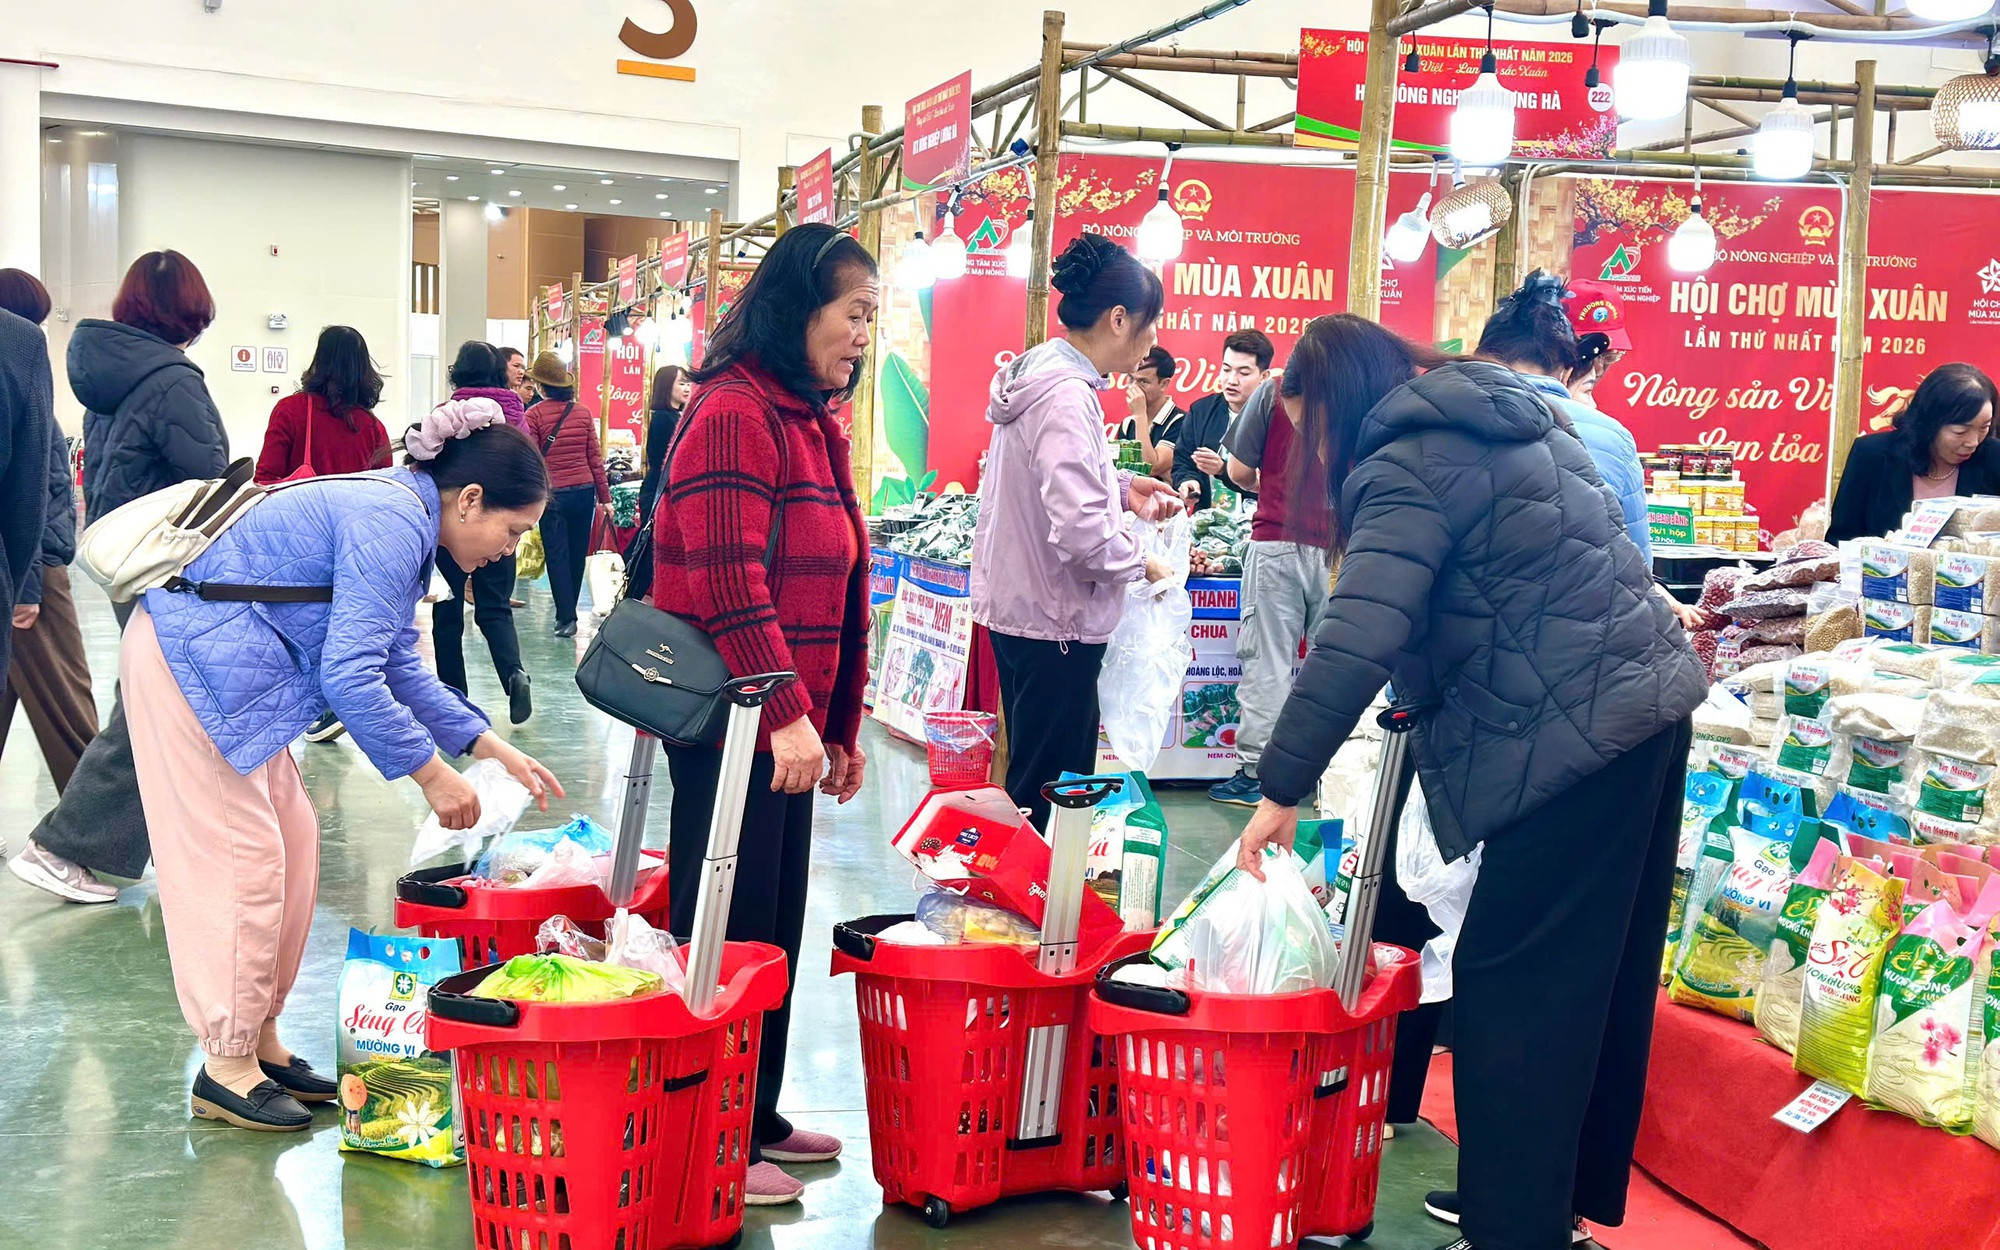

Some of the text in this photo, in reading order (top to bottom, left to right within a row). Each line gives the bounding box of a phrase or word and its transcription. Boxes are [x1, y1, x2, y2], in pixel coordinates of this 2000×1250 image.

[1347, 38, 1365, 55] HỘI
[1417, 42, 1444, 57] XUÂN
[1521, 49, 1546, 62] NĂM
[1547, 51, 1573, 63] 2026
[1541, 88, 1561, 110] HÀ
[1591, 91, 1611, 103] 222
[1196, 228, 1214, 242] VÀ
[1216, 229, 1243, 243] MÔI
[1246, 230, 1300, 246] TRƯỜNG
[1730, 249, 1767, 263] NÔNG
[1769, 251, 1817, 267] NGHIỆP
[1817, 252, 1836, 265] VÀ
[1866, 254, 1918, 269] TRƯỜNG
[1174, 256, 1335, 302] MÙA XUÂN
[1670, 276, 1839, 323] HỘI CHỢ MÙ
[1868, 283, 1948, 322] XUÂN
[1973, 298, 1989, 308] HỘI
[1212, 311, 1256, 332] NĂM
[1968, 309, 1988, 318] MÙA
[1684, 325, 1720, 348] LẦN
[1730, 329, 1767, 350] THỨ
[1773, 328, 1823, 352] NHẤT
[1881, 337, 1927, 355] 2026
[616, 342, 639, 363] HỘI
[1623, 371, 1720, 420] Nông
[1725, 380, 1783, 410] sản
[1769, 432, 1824, 463] tỏa
[1190, 590, 1237, 608] THANH
[1191, 625, 1228, 639] CHUA
[1754, 859, 1775, 876] Gạo
[1758, 901, 1772, 911] VI
[385, 1002, 406, 1012] Gạo
[344, 1004, 397, 1037] Séng
[404, 1044, 415, 1055] VI
